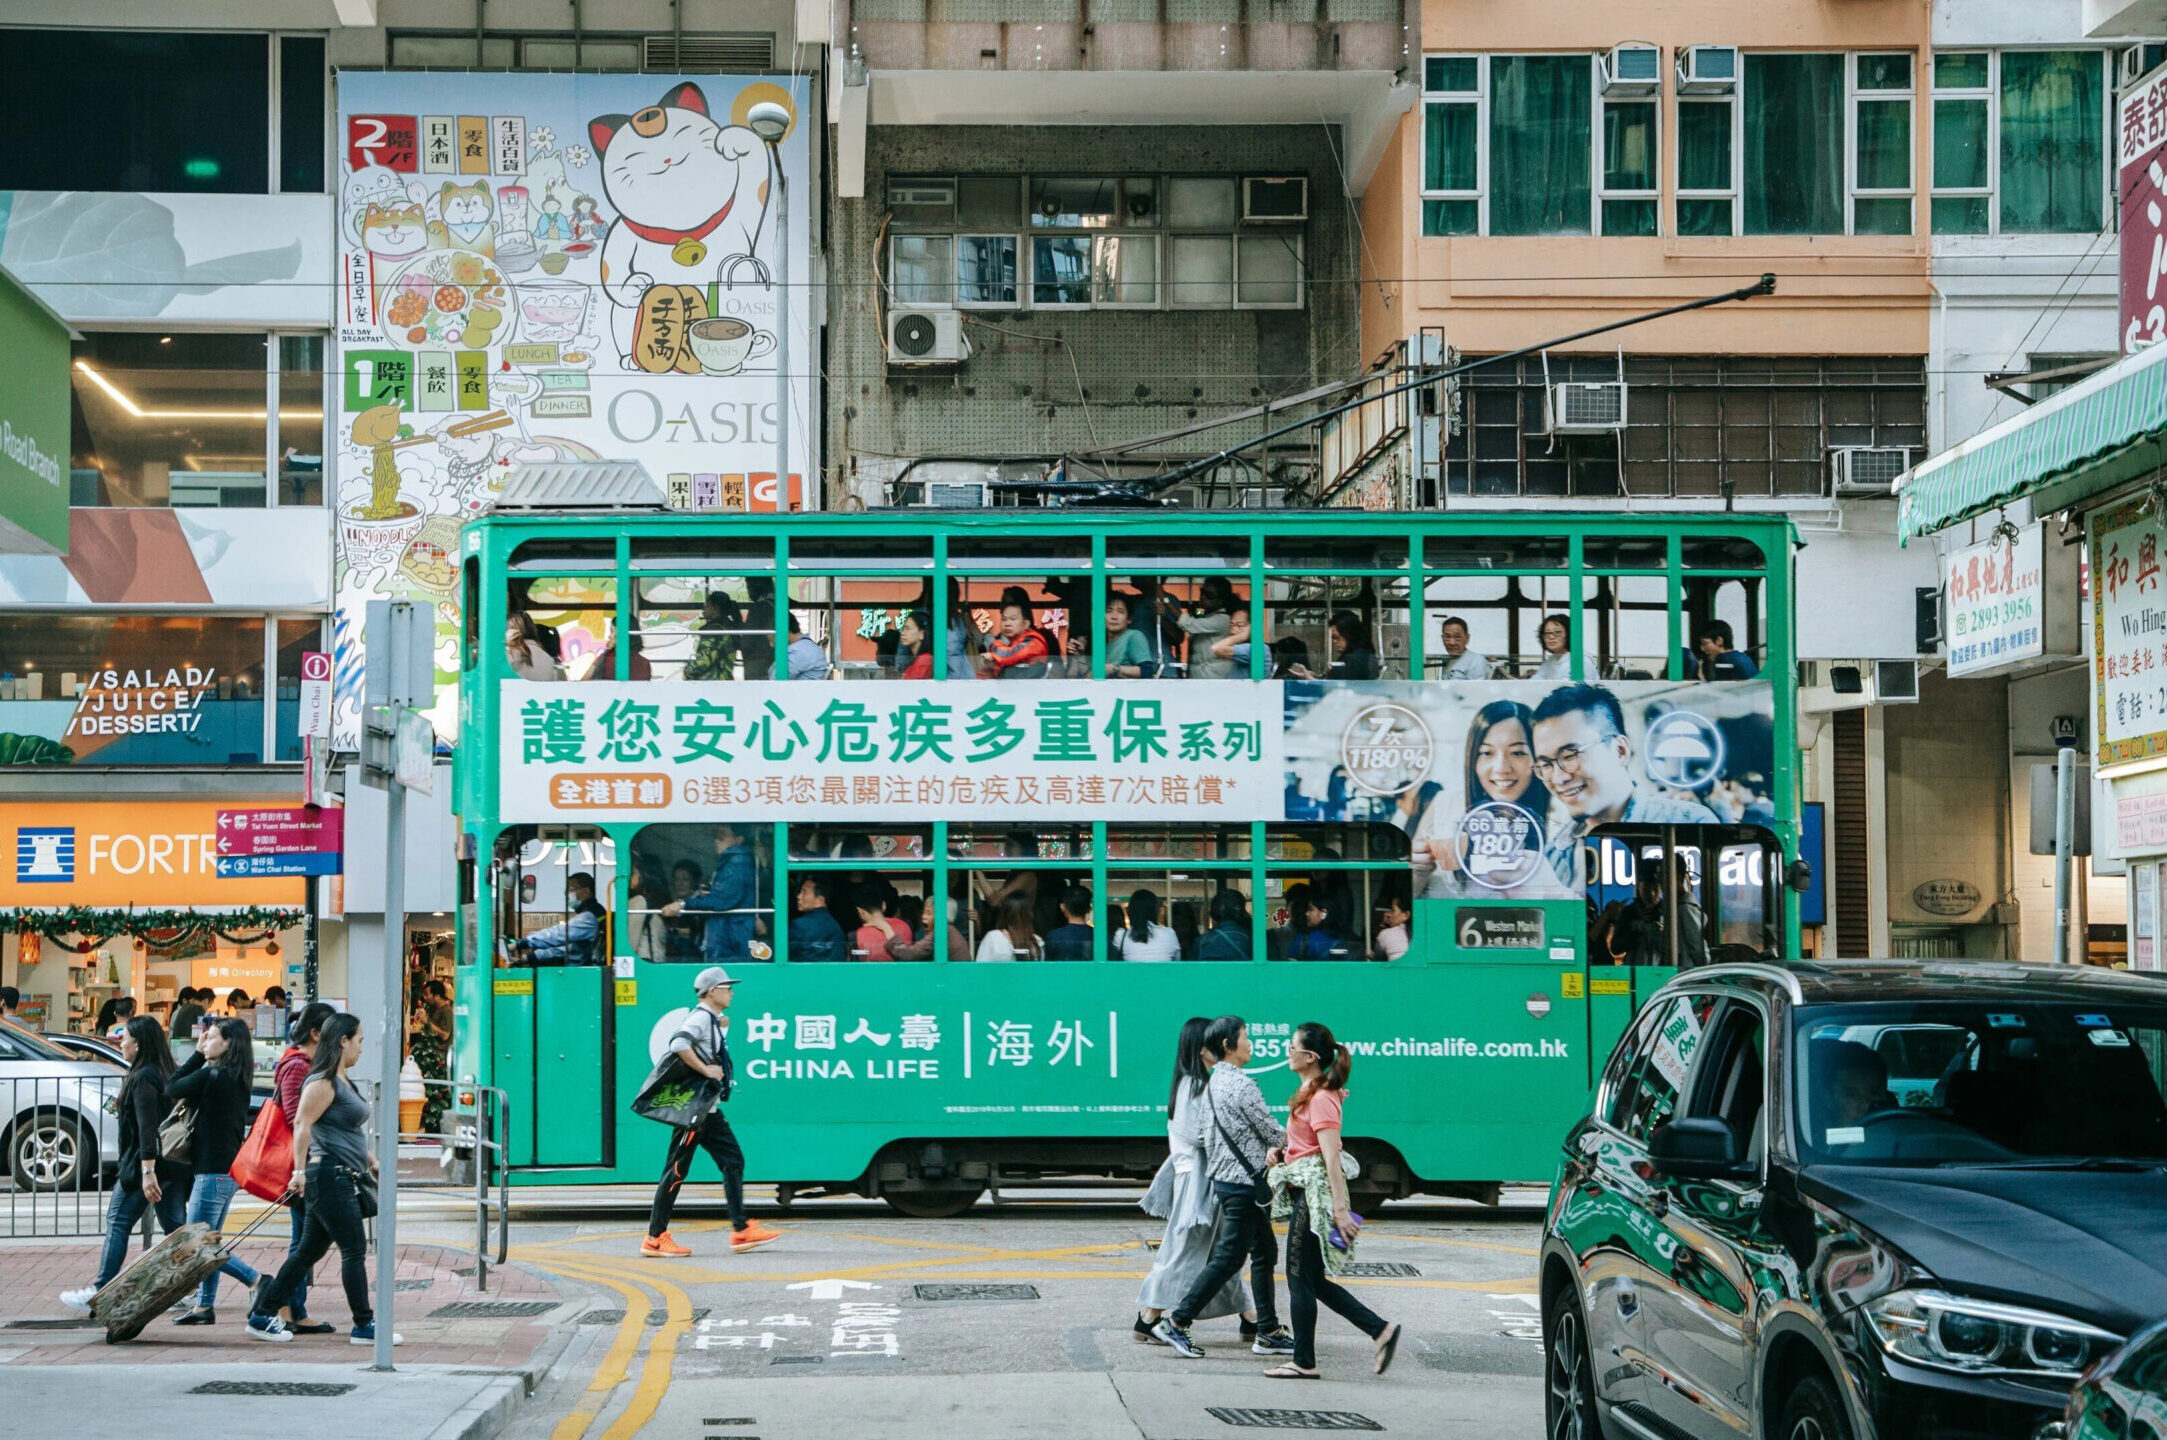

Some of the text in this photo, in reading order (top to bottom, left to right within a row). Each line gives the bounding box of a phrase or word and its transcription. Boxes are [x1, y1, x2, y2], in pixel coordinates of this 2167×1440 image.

[430, 123, 449, 165] 日本酒
[464, 130, 483, 157] 零食
[501, 120, 520, 171] 生活百貨
[725, 298, 776, 314] OASIS
[341, 335, 384, 343] BREAKFAST
[697, 342, 739, 357] OASIS
[511, 347, 551, 360] LUNCH
[426, 366, 447, 394] 餐飲
[463, 366, 482, 394] 零食
[551, 375, 572, 386] TEA
[539, 401, 586, 412] DINNER
[607, 389, 777, 444] OASIS
[4, 419, 60, 488] Road Branch
[2106, 532, 2167, 603] 和興
[1971, 595, 2033, 633] 2893 3956
[2121, 613, 2139, 637] Wo
[309, 685, 322, 733] Wan Chai
[557, 778, 664, 805] 全港首創
[279, 822, 299, 830] Street
[252, 845, 275, 854] Spring
[300, 844, 317, 852] Lane
[250, 866, 266, 874] Wan
[282, 865, 307, 873] Station
[1459, 916, 1483, 948] 6
[231, 967, 274, 978] Directory
[746, 1012, 1095, 1068] 中國人壽 海外
[1337, 1036, 1569, 1058] ww.chinalife.com.hk
[746, 1059, 940, 1080] CHINA LIFE
